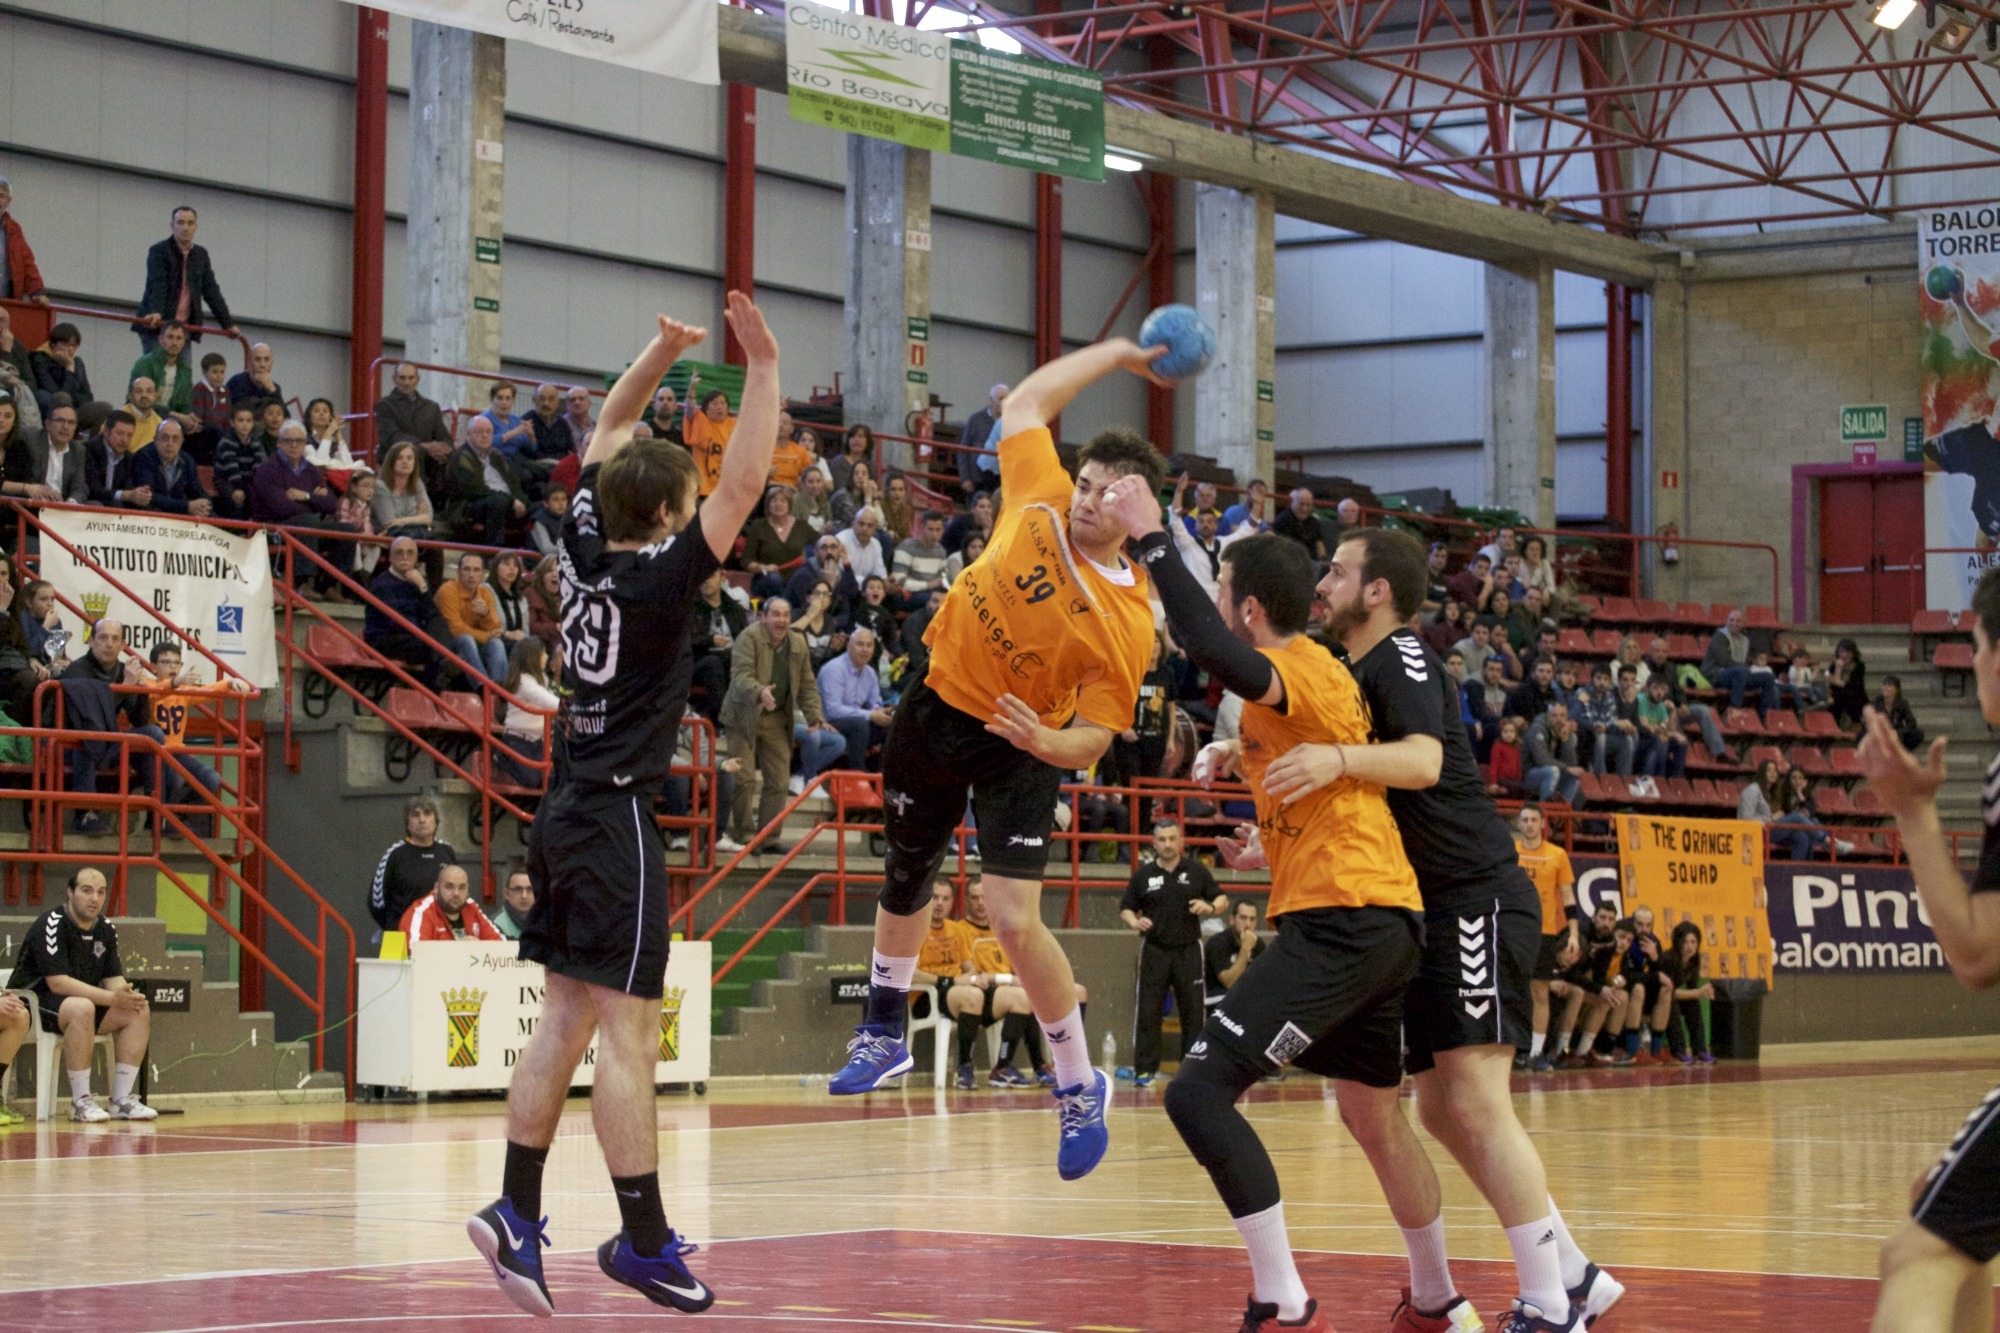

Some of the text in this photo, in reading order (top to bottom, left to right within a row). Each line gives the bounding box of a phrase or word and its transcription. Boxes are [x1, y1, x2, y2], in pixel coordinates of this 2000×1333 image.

[789, 6, 946, 60] Centro Médico
[842, 78, 949, 117] Besaya
[1844, 411, 1885, 435] SALIDA
[86, 521, 157, 536] AYUNTAMIENTO
[159, 527, 169, 537] DE
[1967, 553, 2000, 569] ALE
[154, 588, 171, 612] DE
[1015, 565, 1056, 606] 39
[964, 571, 1014, 652] codelse
[1650, 822, 1733, 856] THE ORANGE
[1667, 861, 1718, 884] SQUAD
